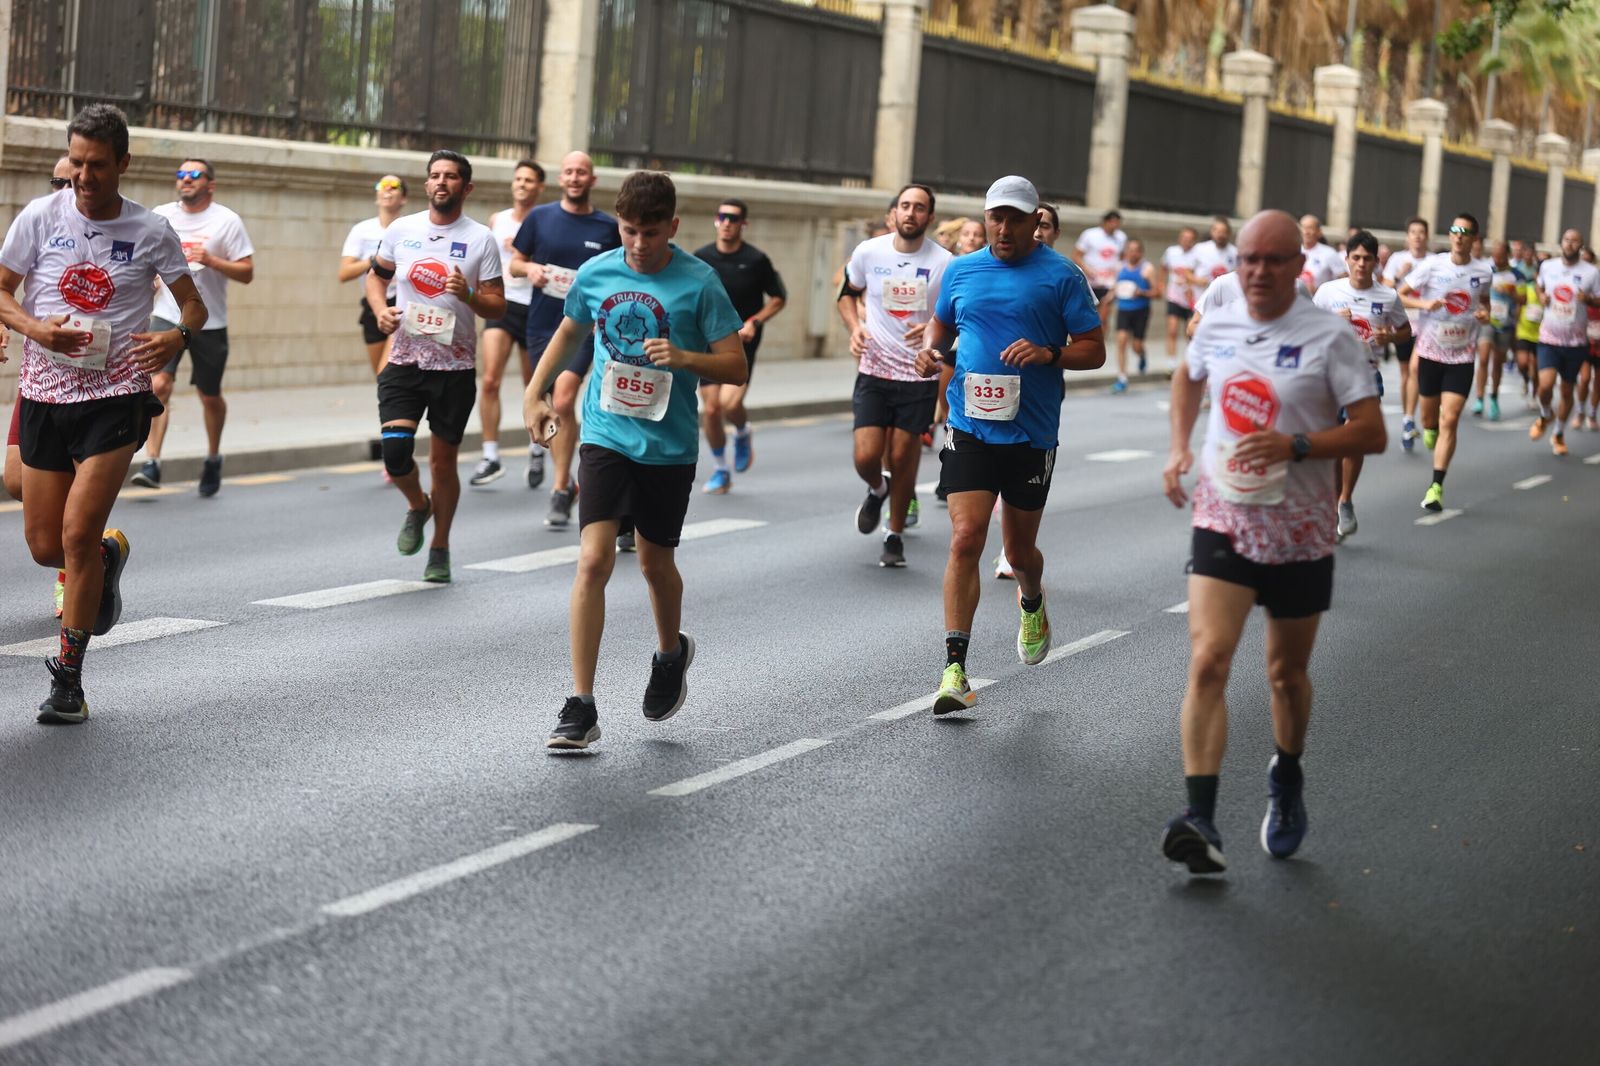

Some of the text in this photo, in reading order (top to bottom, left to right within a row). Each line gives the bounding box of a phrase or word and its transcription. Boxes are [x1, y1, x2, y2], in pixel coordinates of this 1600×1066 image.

[412, 272, 444, 289] FRENO
[415, 265, 447, 283] PONLE
[892, 287, 916, 296] 935
[610, 292, 660, 311] TRIATLON
[417, 313, 444, 326] 515
[616, 376, 655, 395] 855
[974, 385, 1005, 398] 333
[1228, 384, 1272, 413] PONLE
